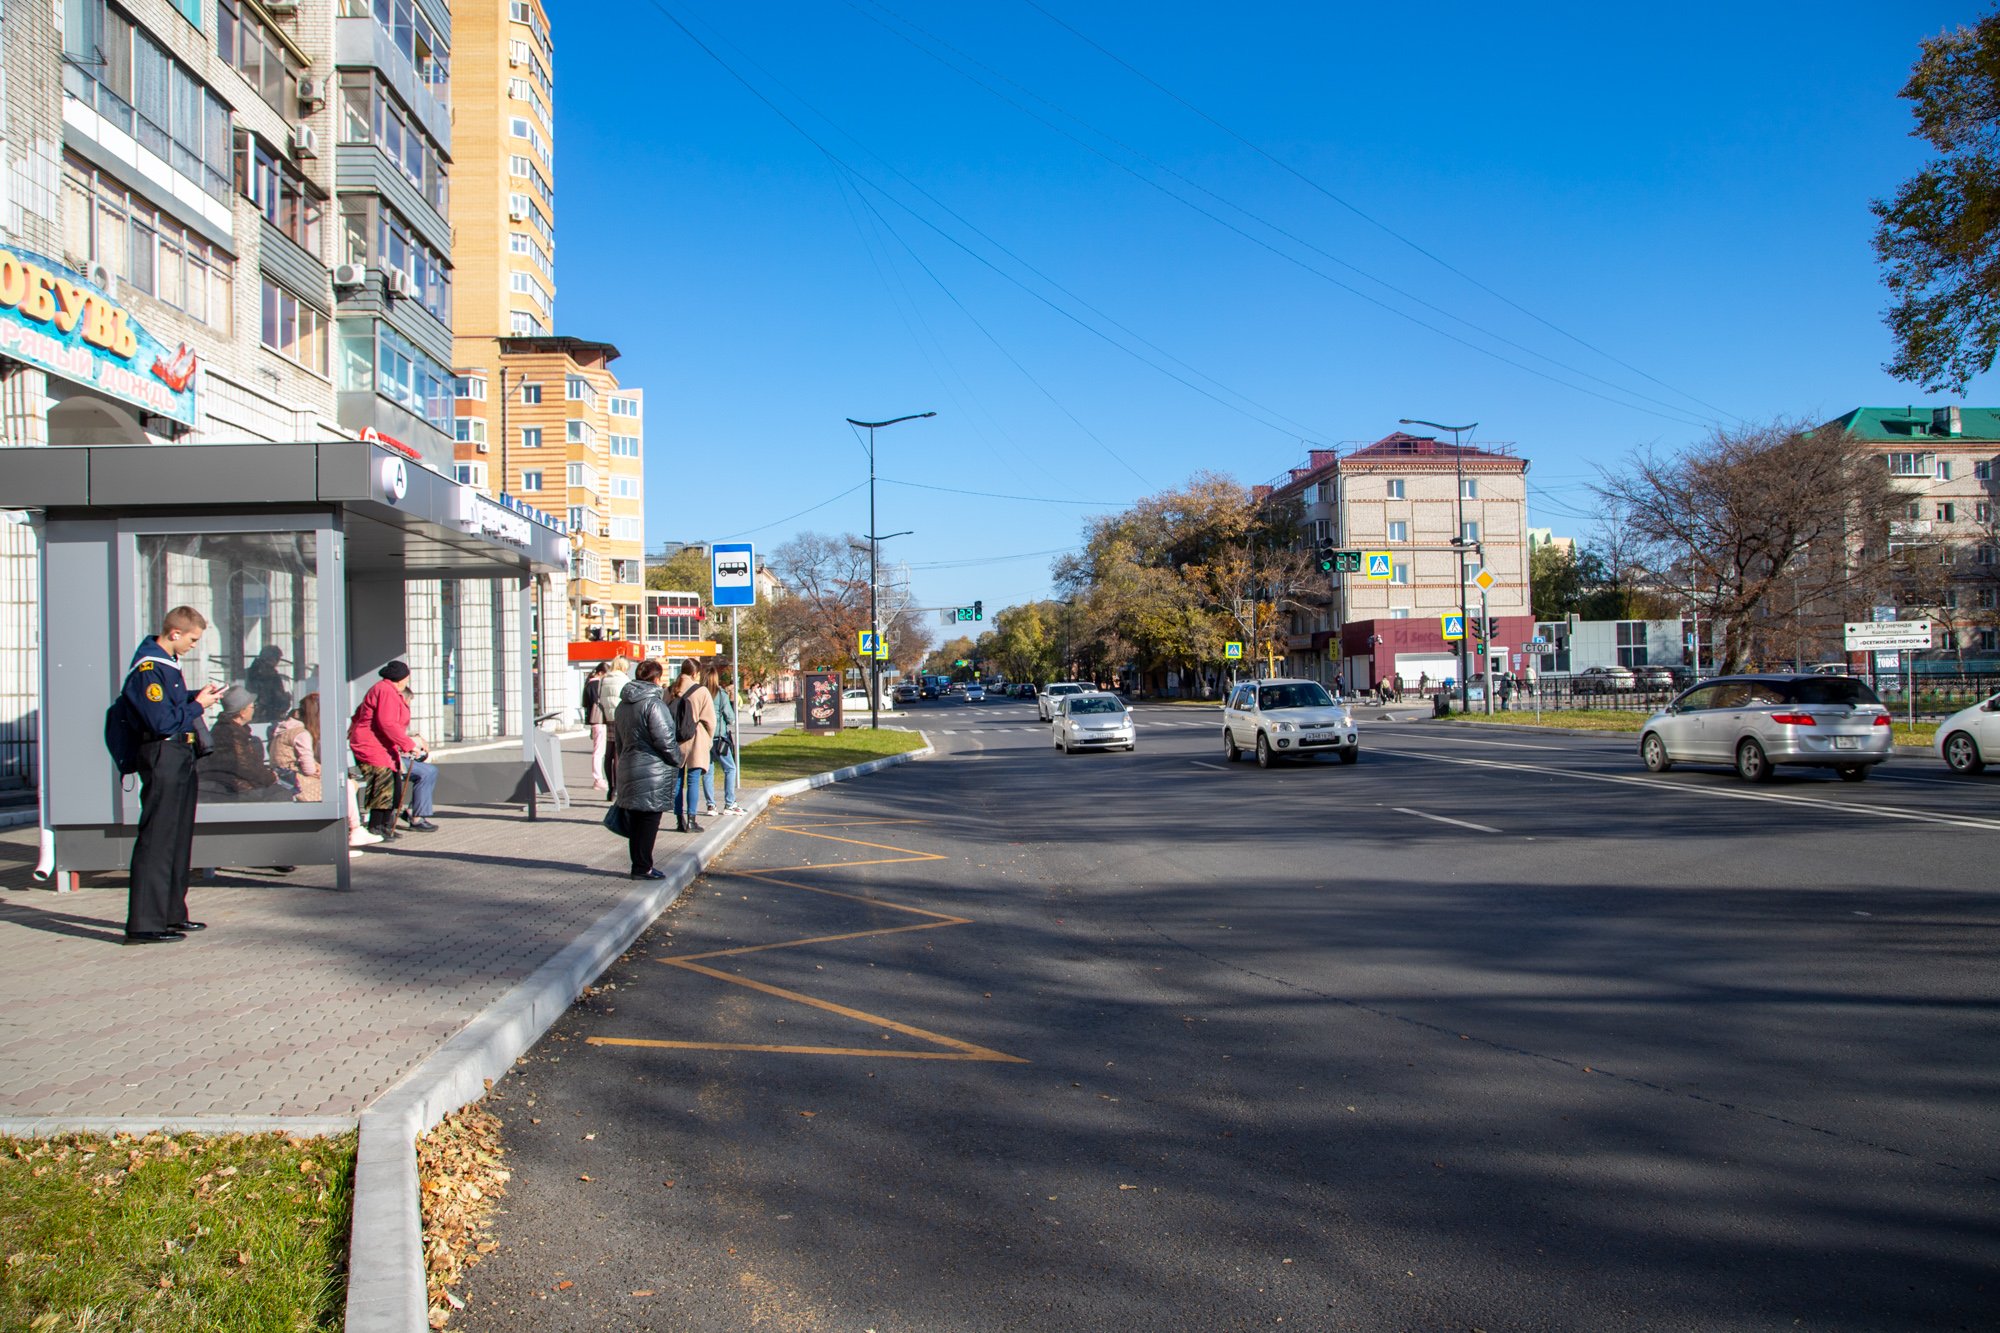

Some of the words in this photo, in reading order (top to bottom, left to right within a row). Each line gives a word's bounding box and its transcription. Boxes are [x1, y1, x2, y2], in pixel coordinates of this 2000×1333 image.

[0, 250, 137, 360] ОБУВЬ
[99, 360, 177, 412] ДОЖДЬ
[1336, 553, 1359, 571] 23
[660, 607, 697, 616] ПРЕЗИДЕНТ
[958, 609, 973, 620] 22
[1876, 622, 1912, 630] Кузнечная
[1525, 644, 1550, 652] СТОП
[1876, 658, 1899, 668] TODES
